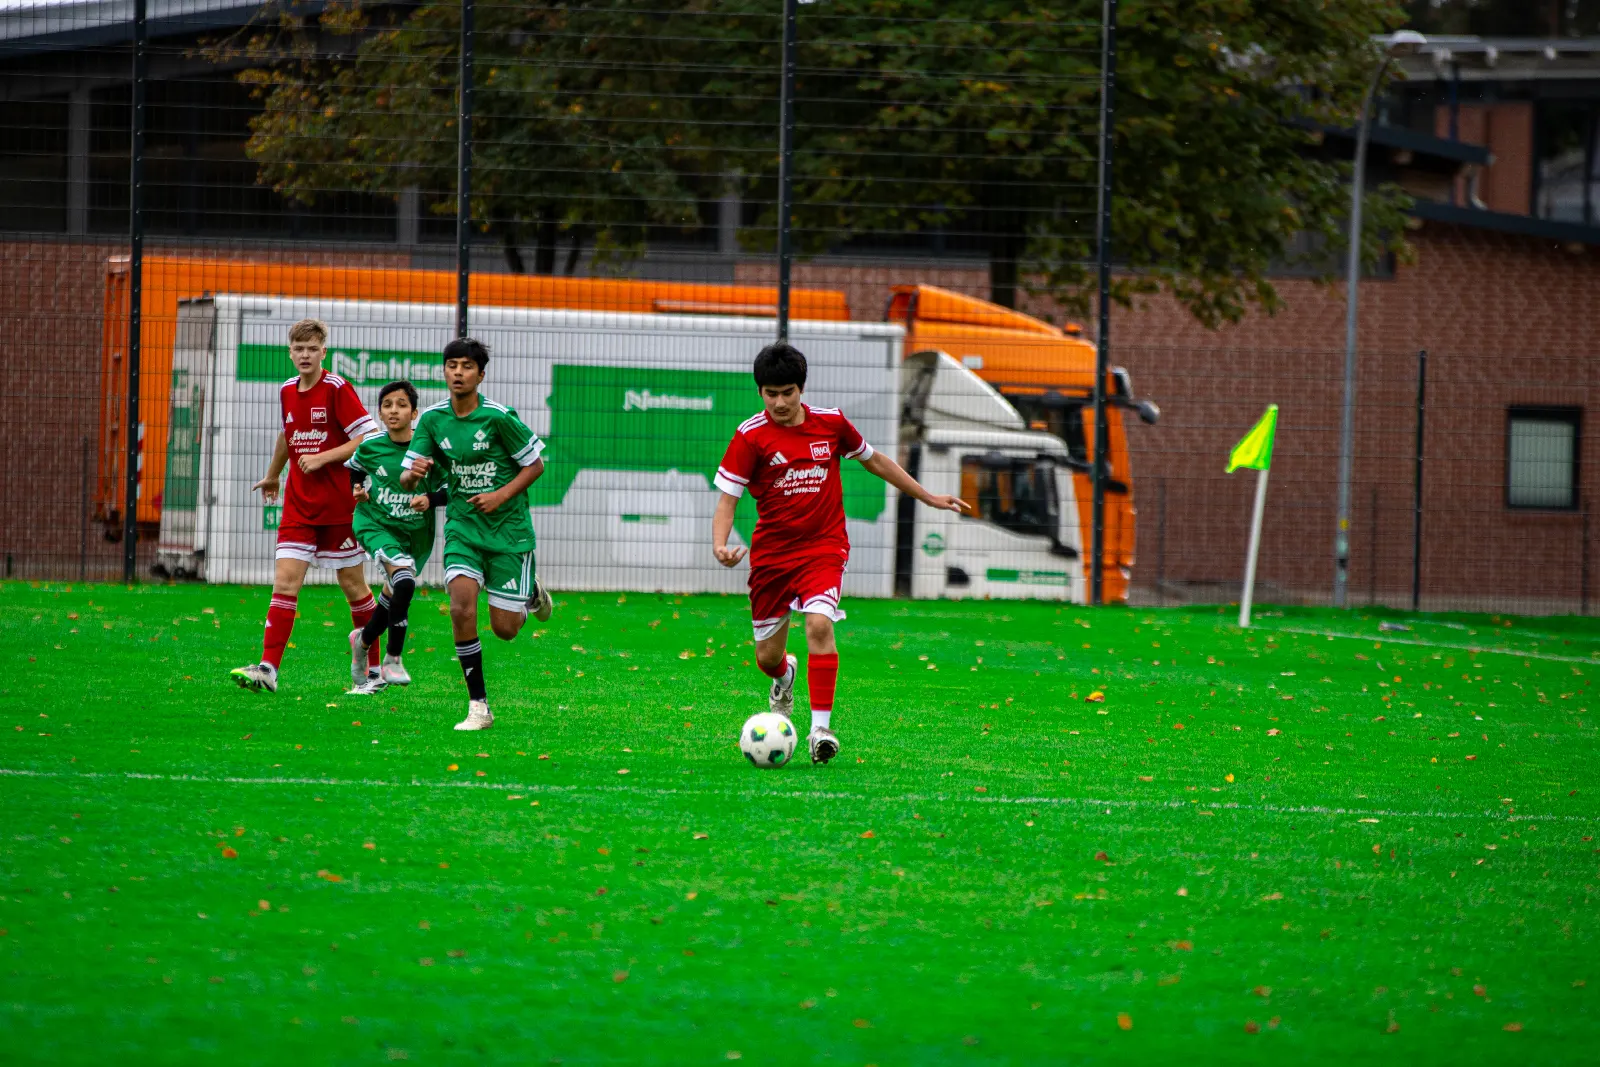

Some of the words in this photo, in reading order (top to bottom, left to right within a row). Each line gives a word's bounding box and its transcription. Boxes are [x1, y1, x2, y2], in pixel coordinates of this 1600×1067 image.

[331, 351, 445, 384] Nehlse
[473, 442, 489, 450] SFN
[785, 465, 828, 481] Everding
[460, 475, 493, 488] Kiosk
[376, 487, 427, 504] Ham
